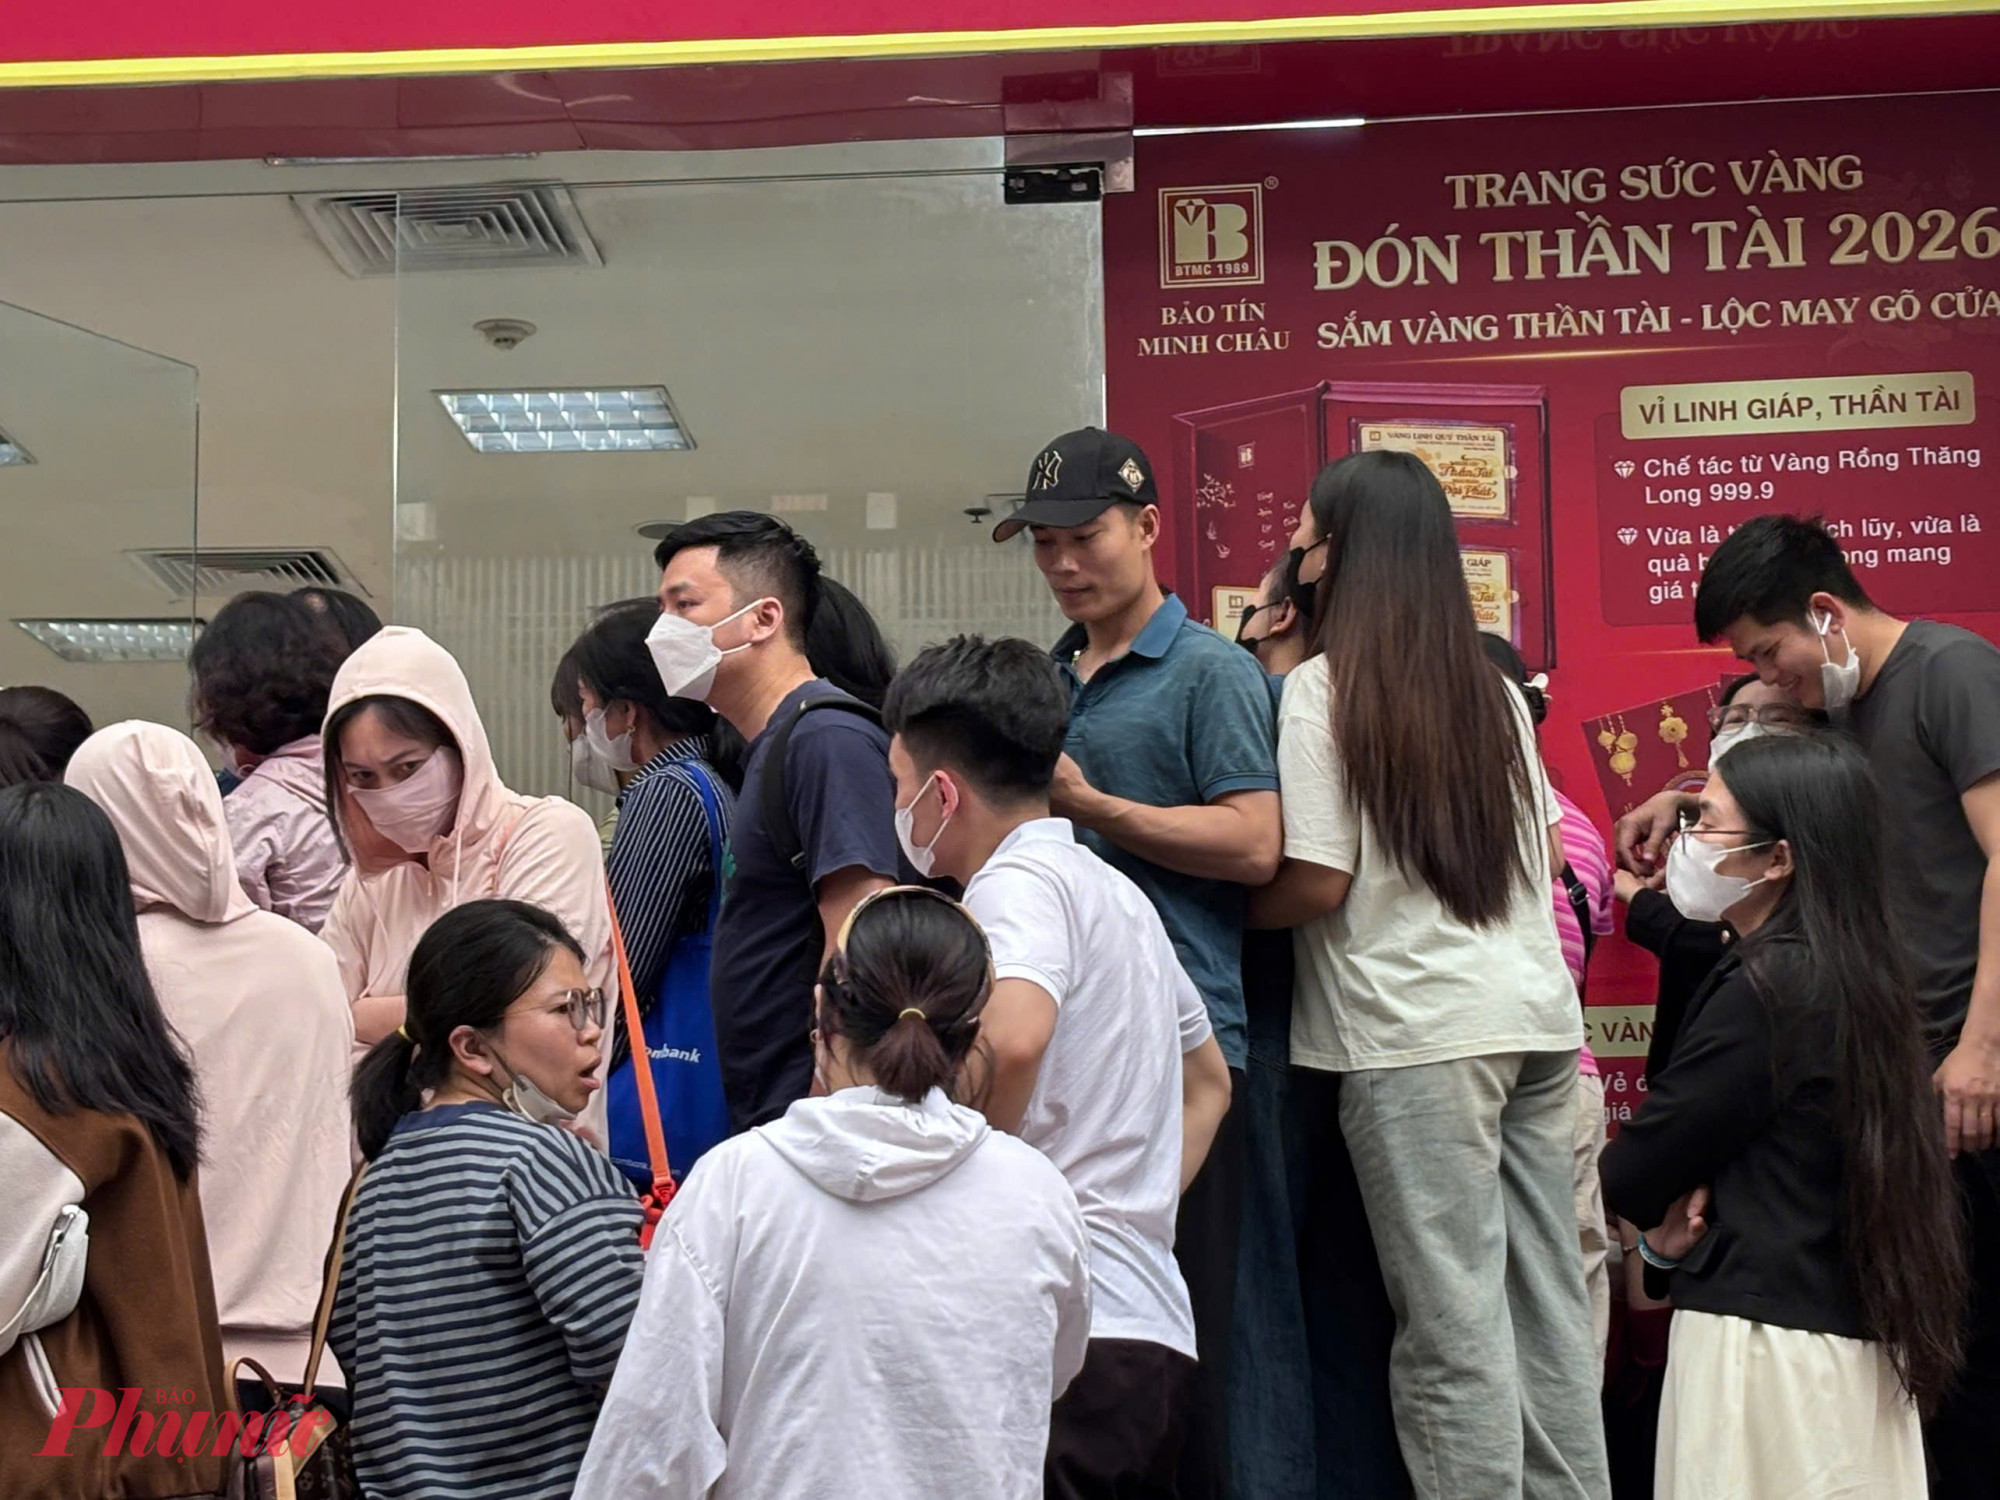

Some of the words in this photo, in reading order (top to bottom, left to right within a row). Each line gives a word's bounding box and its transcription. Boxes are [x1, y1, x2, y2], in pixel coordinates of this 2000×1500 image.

[1444, 168, 1607, 209] TRANG
[1620, 156, 1716, 200] SỨC
[1728, 150, 1864, 195] VÀNG
[1313, 223, 1461, 290] ĐÓN
[1479, 211, 1673, 281] THẦN
[1691, 205, 1806, 271] TÀI
[1828, 207, 2000, 265] 2026
[1175, 264, 1212, 277] BTMC
[1217, 262, 1249, 275] 1989
[1160, 301, 1215, 326] BẢO
[1221, 298, 1266, 323] TÍN
[1317, 310, 1392, 349] SẮM
[1401, 311, 1499, 344] VÀNG
[1507, 303, 1605, 339] THẦN
[1613, 300, 1671, 334] TÀI
[1701, 297, 1771, 335] LỘC
[1780, 298, 1860, 327] MAY
[1870, 290, 1920, 322] GÕ
[1930, 285, 2000, 319] CỬA
[1137, 334, 1209, 356] MINH
[1215, 327, 1291, 353] CHÂU
[1639, 395, 1666, 425] VỈ
[1674, 400, 1738, 424] LINH
[1746, 392, 1822, 422] GIÁP,
[1830, 385, 1908, 416] THẦN
[1915, 384, 1960, 412] TÀI
[1643, 452, 1691, 478] Chế
[1697, 455, 1733, 475] tác
[1740, 452, 1764, 473] từ
[1770, 450, 1830, 475] Vàng
[1838, 445, 1901, 470] Rồng
[1907, 444, 1982, 469] Thăng
[1645, 485, 1702, 507] Long
[1709, 481, 1775, 501] 999.9
[1646, 524, 1693, 546] Vừa
[1700, 525, 1720, 543] là
[1861, 517, 1903, 539] lũy,
[1910, 515, 1954, 534] vừa
[1960, 514, 1981, 533] là
[1647, 552, 1691, 576] quà
[1887, 545, 1951, 566] mang
[1648, 580, 1684, 605] giá
[1600, 1016, 1656, 1043] VÀN
